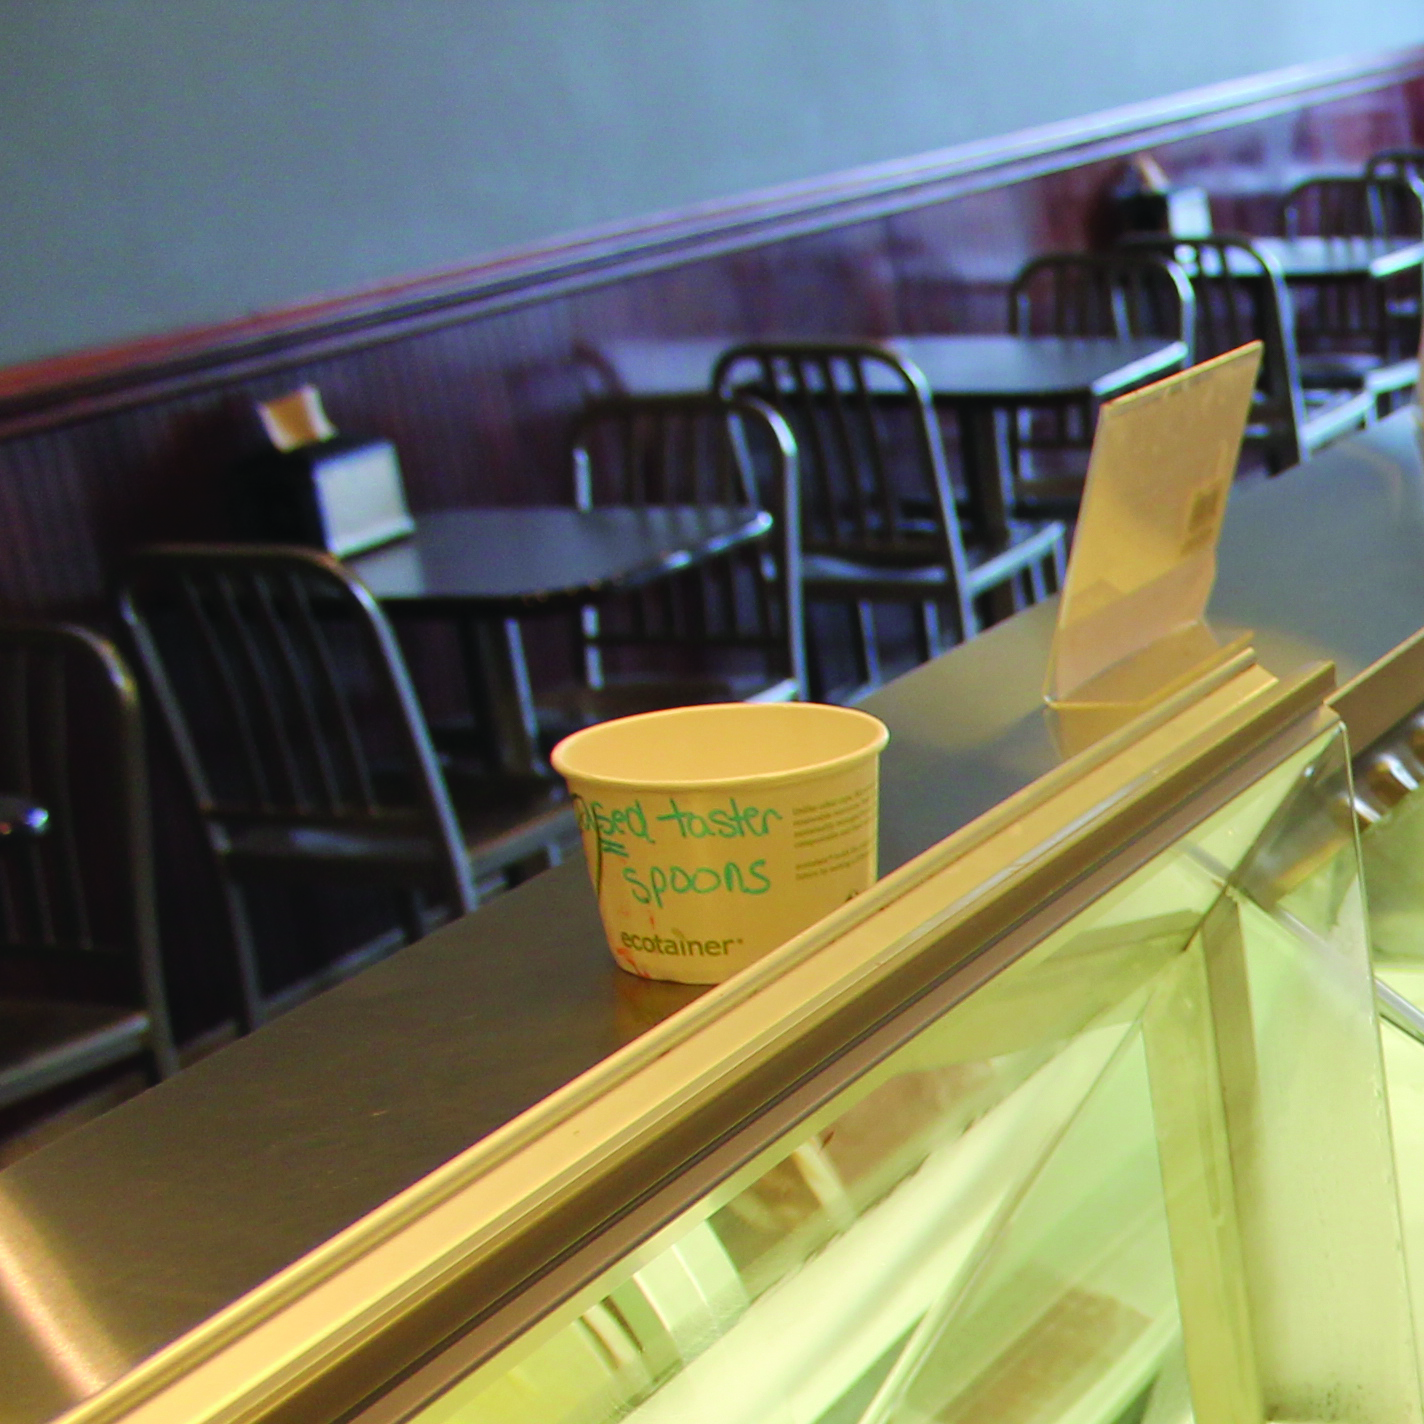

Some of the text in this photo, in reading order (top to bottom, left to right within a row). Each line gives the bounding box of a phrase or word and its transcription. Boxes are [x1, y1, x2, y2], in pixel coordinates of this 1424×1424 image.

[657, 797, 783, 838] taster
[622, 858, 772, 908] spoons
[620, 931, 734, 957] ecotainer
